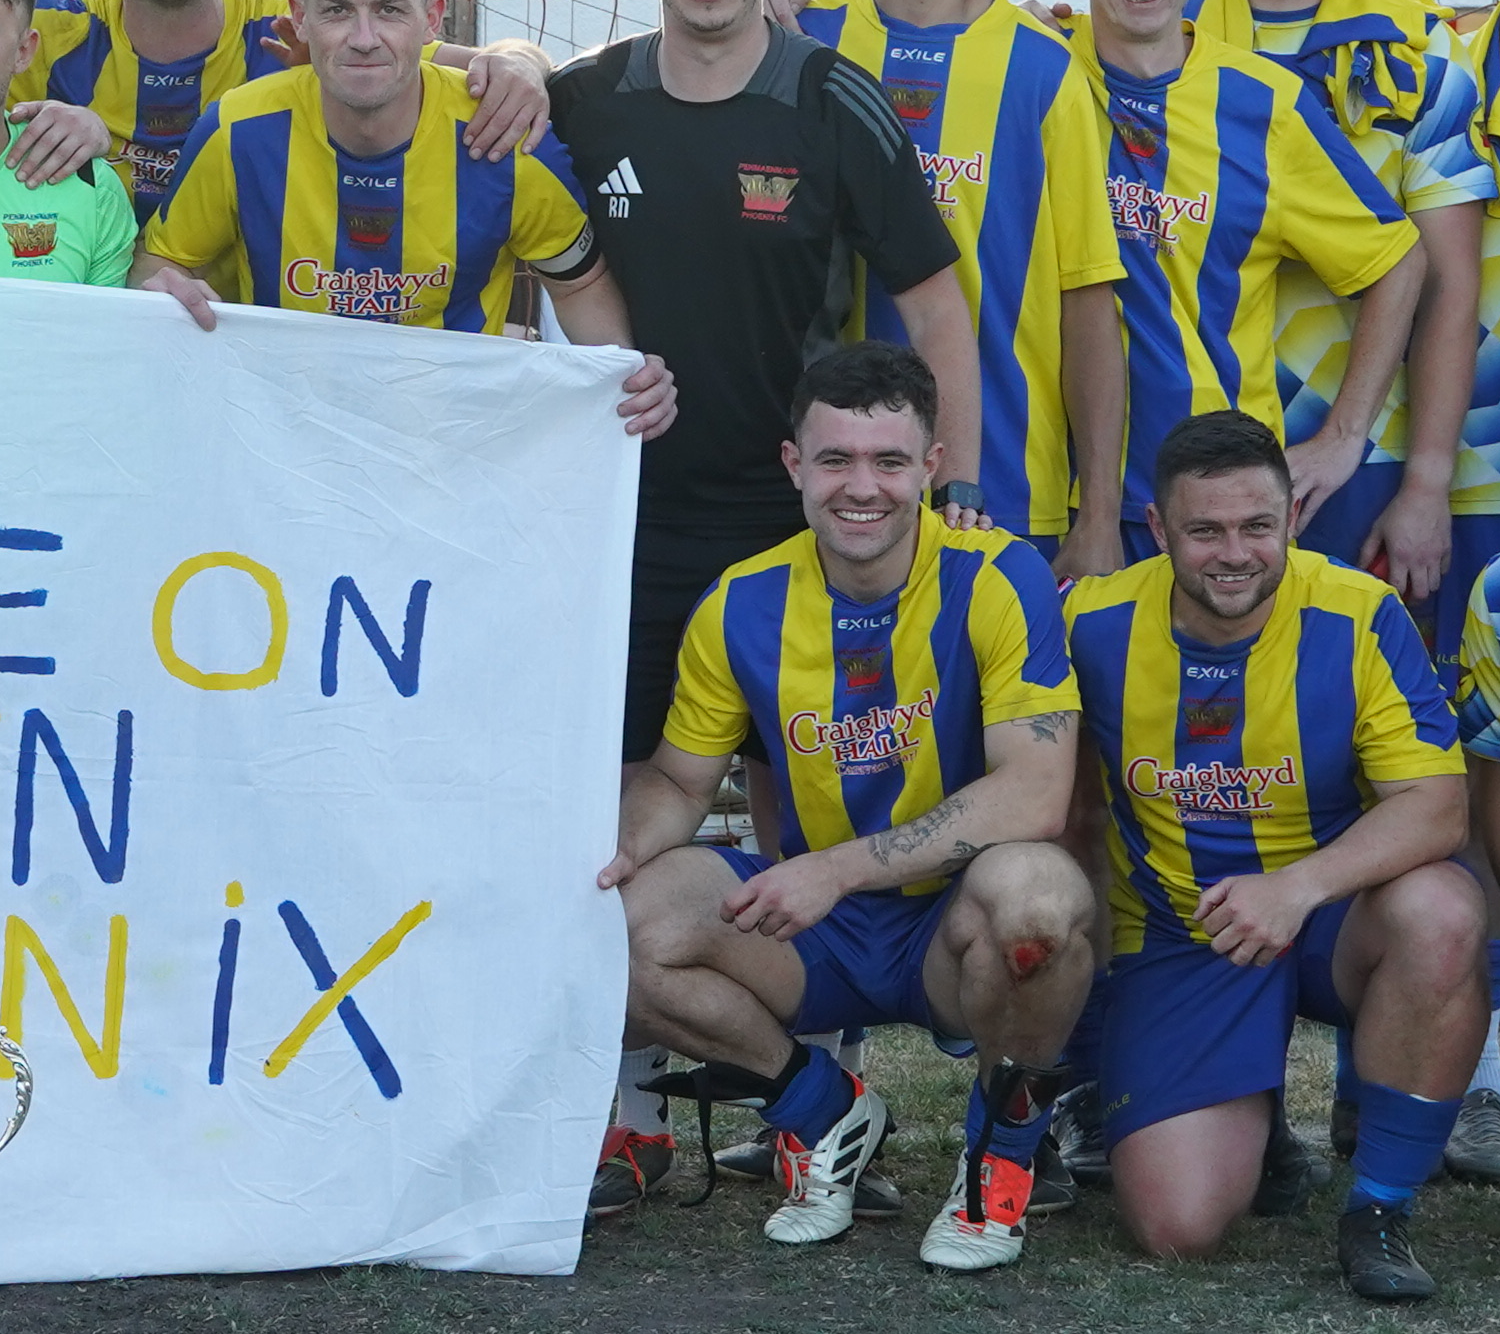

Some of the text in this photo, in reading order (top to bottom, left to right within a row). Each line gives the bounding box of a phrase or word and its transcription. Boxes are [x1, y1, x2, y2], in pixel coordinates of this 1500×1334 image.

[891, 48, 946, 63] EXILE
[143, 74, 196, 87] EXILE
[343, 175, 397, 188] EXILE
[286, 258, 448, 299] Craiglwyd
[328, 294, 422, 315] HALL
[152, 551, 432, 698] ON
[837, 615, 892, 630] EXILE
[832, 731, 920, 763] HALL
[1127, 756, 1297, 798] Craiglwyd
[1171, 791, 1274, 811] HALL
